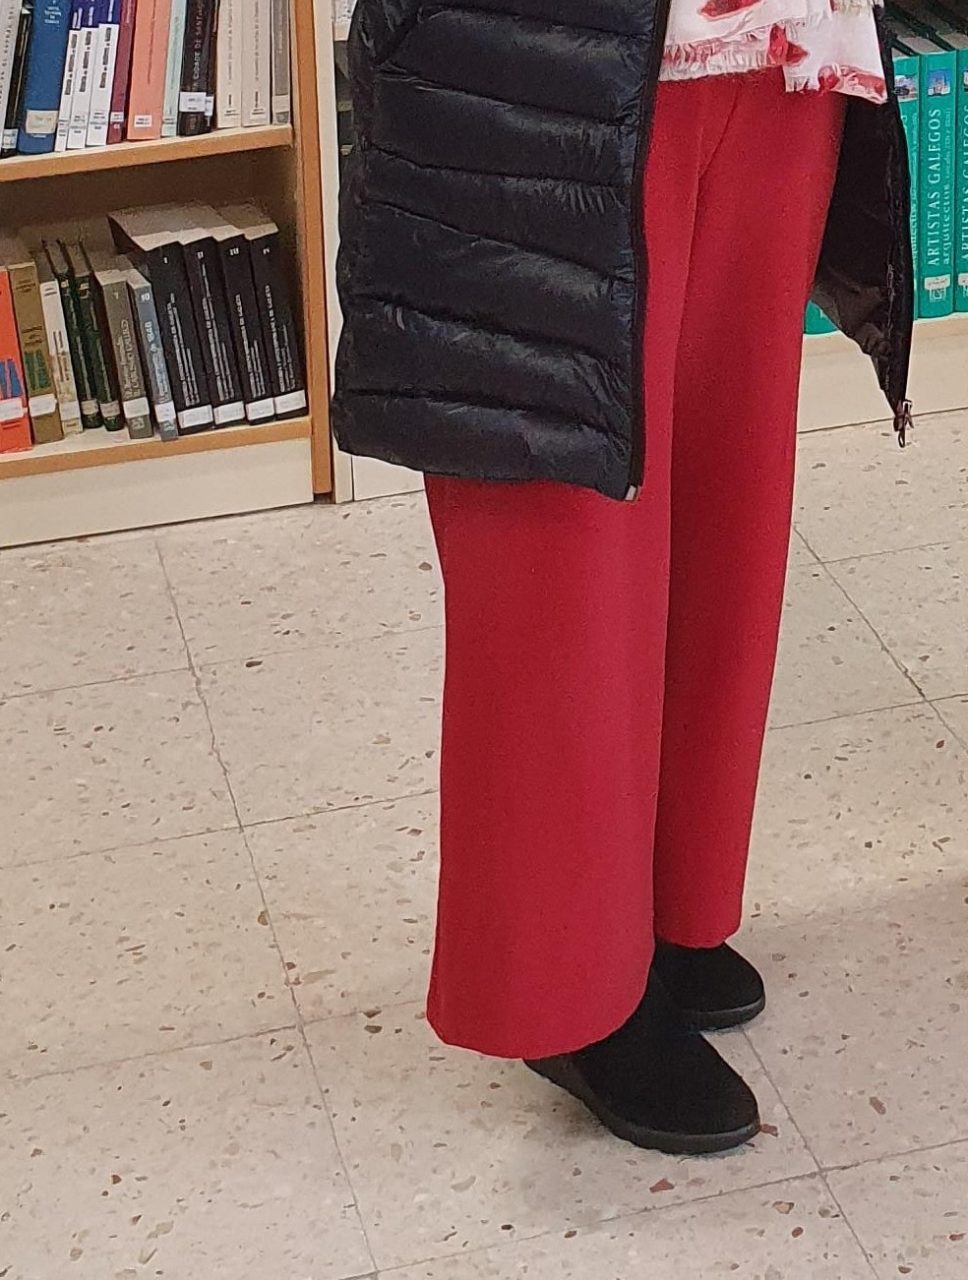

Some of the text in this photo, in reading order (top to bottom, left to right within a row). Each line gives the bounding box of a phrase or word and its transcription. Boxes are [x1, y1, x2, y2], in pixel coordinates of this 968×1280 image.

[927, 108, 942, 266] ARTISTAS GALEGOS
[942, 185, 952, 265] arquitectos
